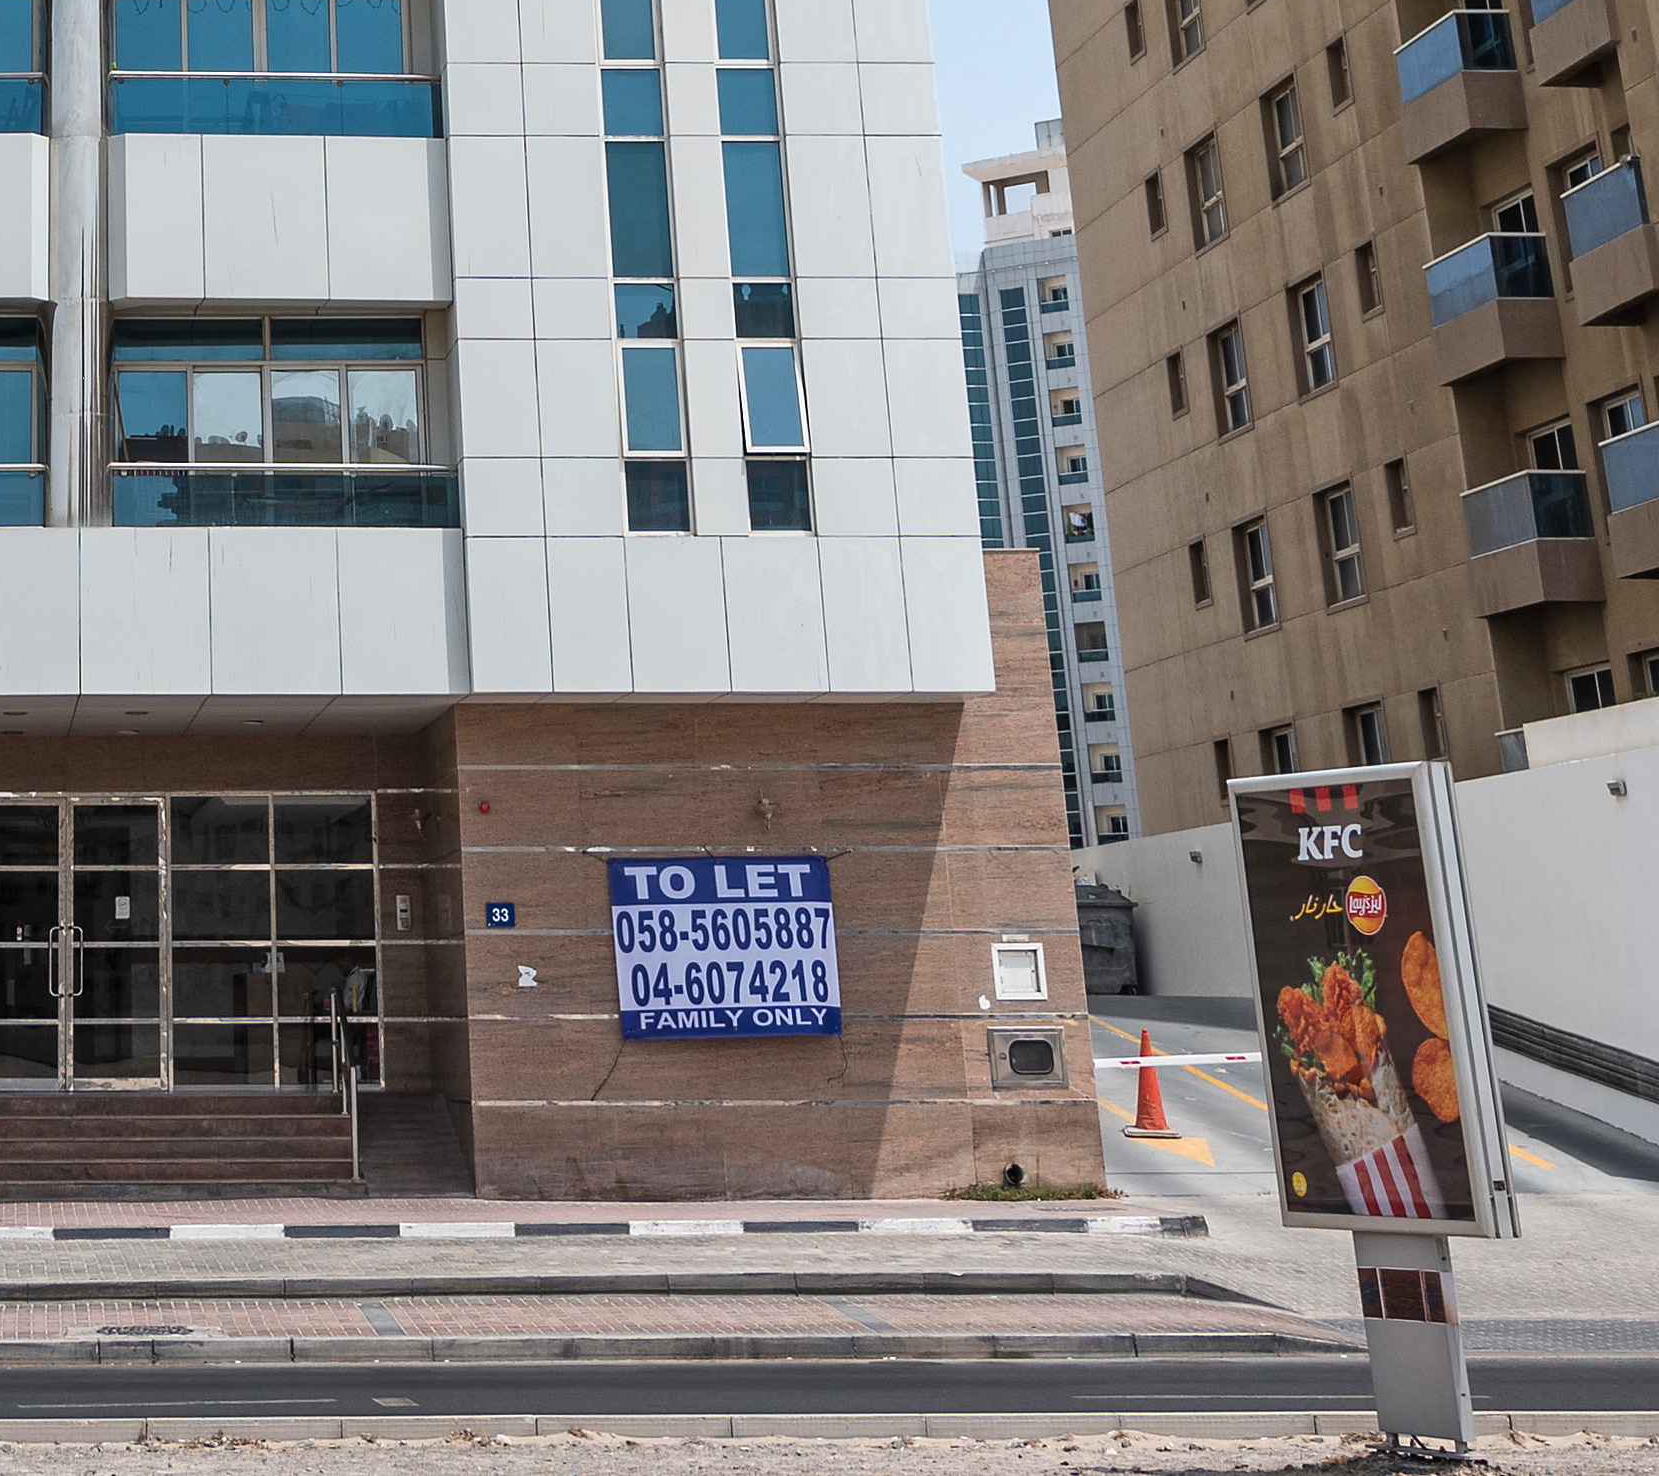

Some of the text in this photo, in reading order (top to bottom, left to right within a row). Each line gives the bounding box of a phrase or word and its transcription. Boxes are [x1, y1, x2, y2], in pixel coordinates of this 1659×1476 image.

[1297, 823, 1363, 861] KFC
[623, 864, 811, 899] TO LET
[492, 908, 509, 922] 33
[1295, 894, 1343, 919] حار نار
[616, 907, 830, 953] 058-5605887
[631, 959, 829, 1007] 04-6074218
[639, 1008, 827, 1030] FAMILY ONLY
